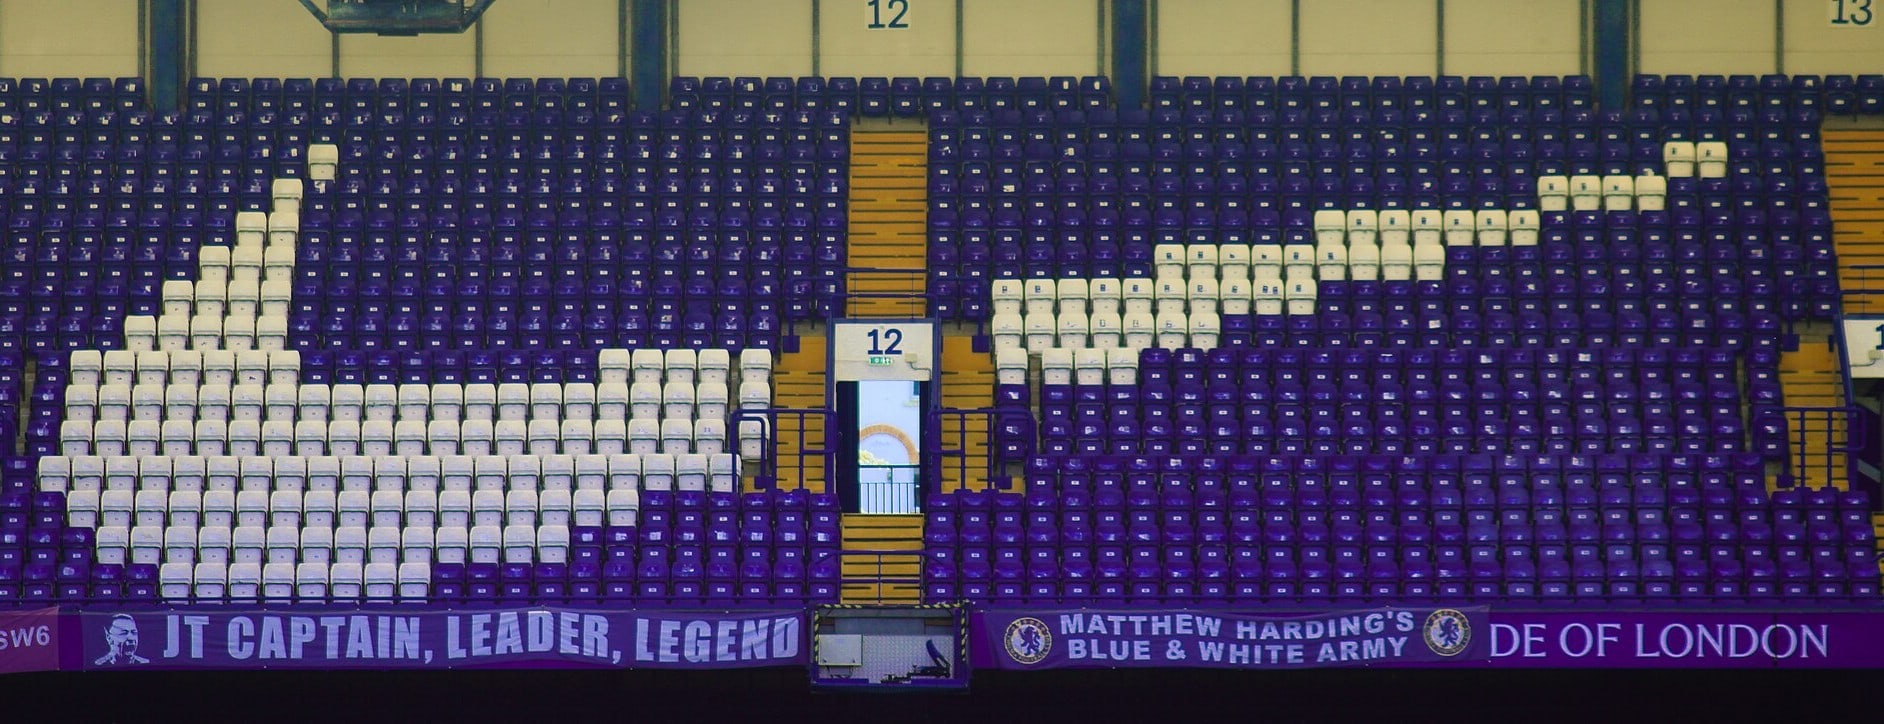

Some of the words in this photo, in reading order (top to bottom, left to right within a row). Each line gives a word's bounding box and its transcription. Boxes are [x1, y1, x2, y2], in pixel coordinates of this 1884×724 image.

[867, 0, 909, 29] 12
[1831, 0, 1873, 26] 13
[867, 328, 903, 355] 12
[163, 614, 210, 659] JT
[227, 615, 434, 664] CAPTAIN,
[447, 610, 622, 665] LEADER,
[636, 616, 799, 663] LEGEND
[1059, 613, 1222, 637] MATTHEW
[1236, 610, 1415, 640] HARDING'S
[1067, 638, 1151, 661] BLUE
[1165, 638, 1187, 660] &
[1199, 639, 1305, 664] WHITE
[1316, 636, 1409, 663] ARMY
[1490, 623, 1547, 658] DE
[1559, 622, 1622, 659] OF
[1635, 622, 1829, 659] LONDON
